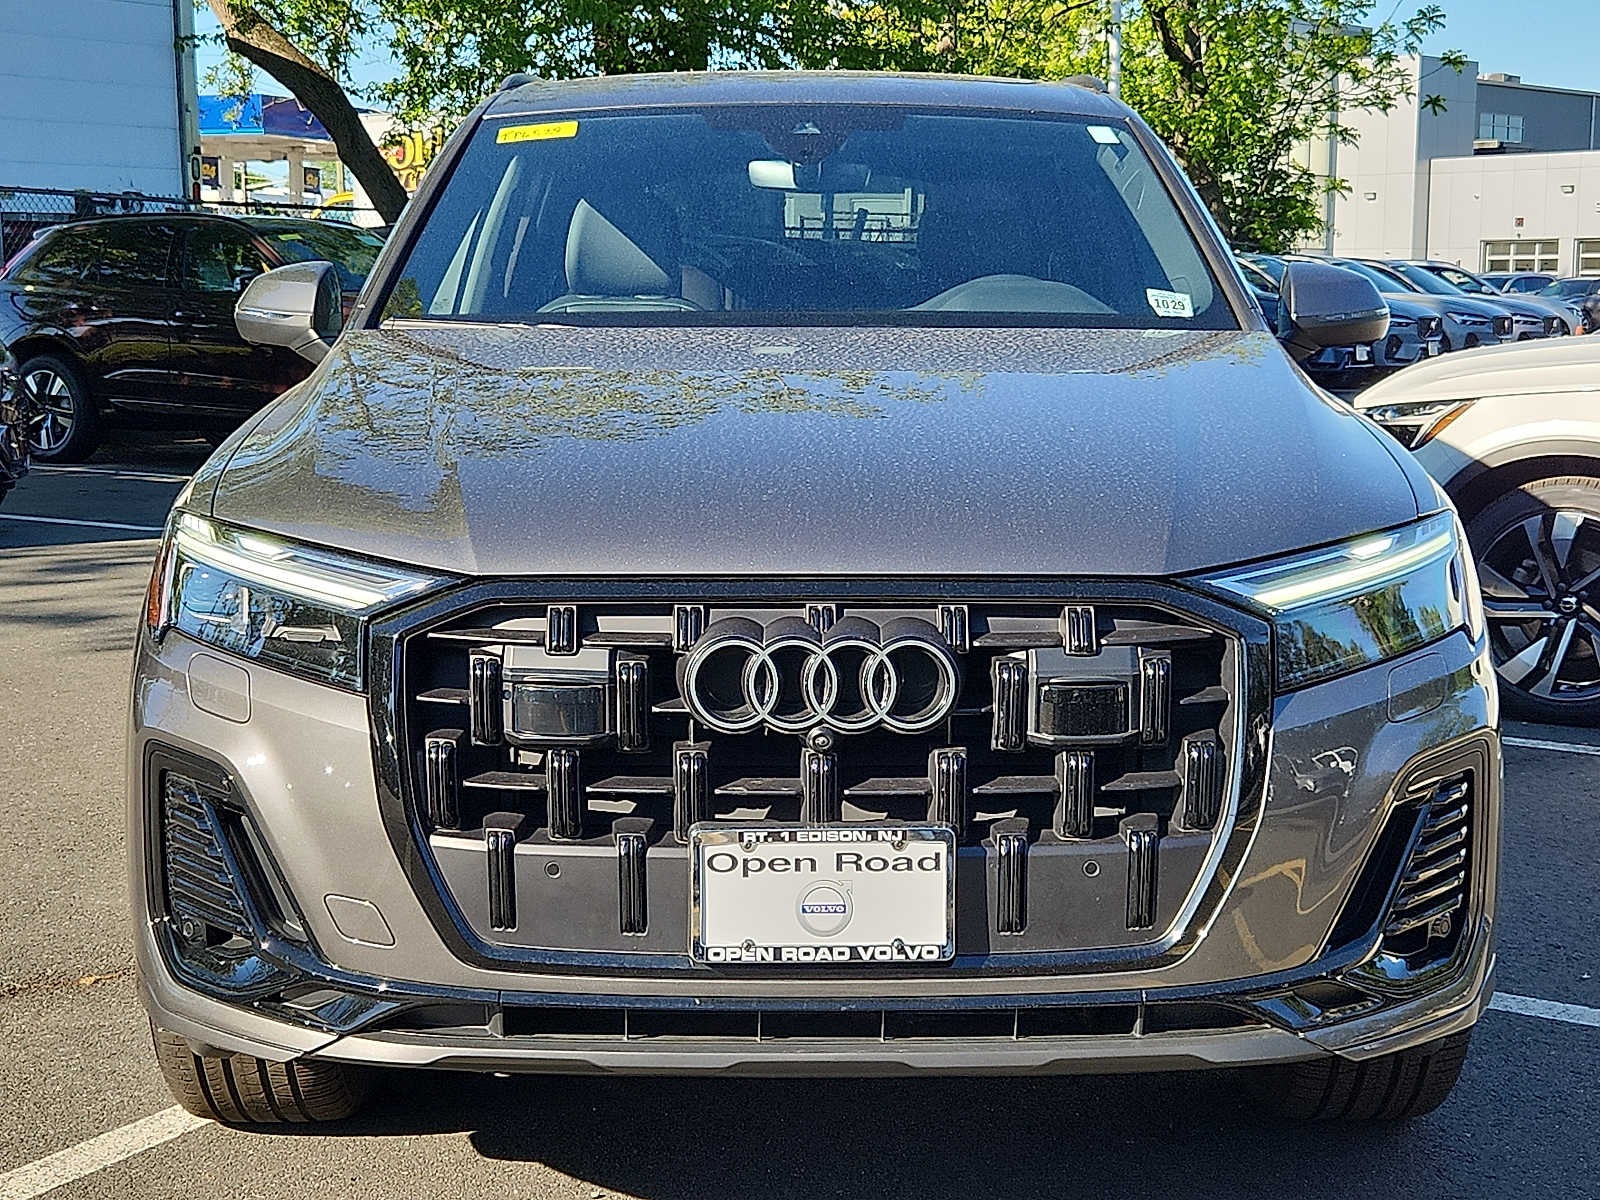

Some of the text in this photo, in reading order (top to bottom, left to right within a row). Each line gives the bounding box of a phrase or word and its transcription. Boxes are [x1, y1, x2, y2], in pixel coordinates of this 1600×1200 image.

[743, 830, 903, 843] RT. 1 EDISON, NJ
[706, 851, 941, 878] Open Road
[803, 904, 846, 914] VOLVO
[707, 944, 941, 962] OPEN ROAD VOLVO
